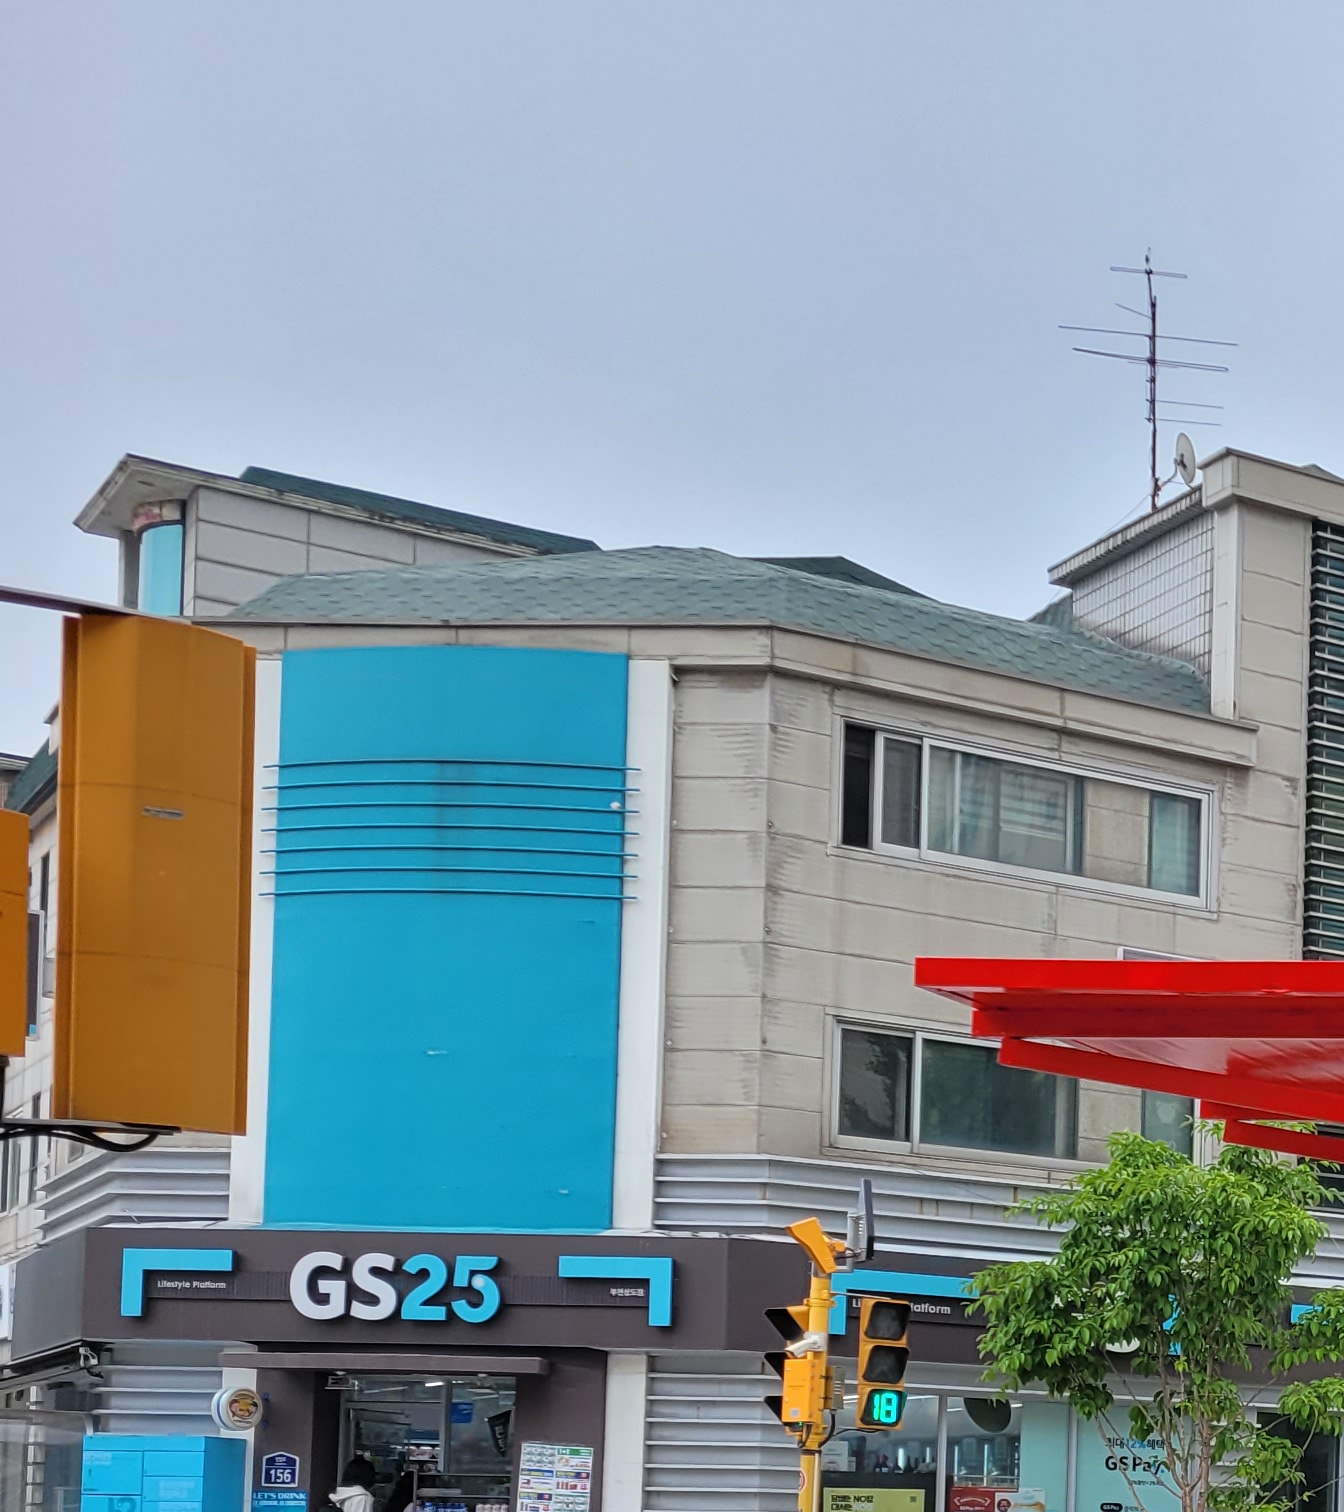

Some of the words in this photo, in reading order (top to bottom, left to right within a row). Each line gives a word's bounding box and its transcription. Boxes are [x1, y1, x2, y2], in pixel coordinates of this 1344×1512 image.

[157, 1280, 191, 1290] Lifestyle
[192, 1280, 227, 1290] Platform
[289, 1251, 500, 1323] GS25
[909, 1301, 951, 1315] latform
[873, 1392, 898, 1424] 18
[269, 1468, 292, 1483] 156
[277, 1492, 307, 1500] DRINK
